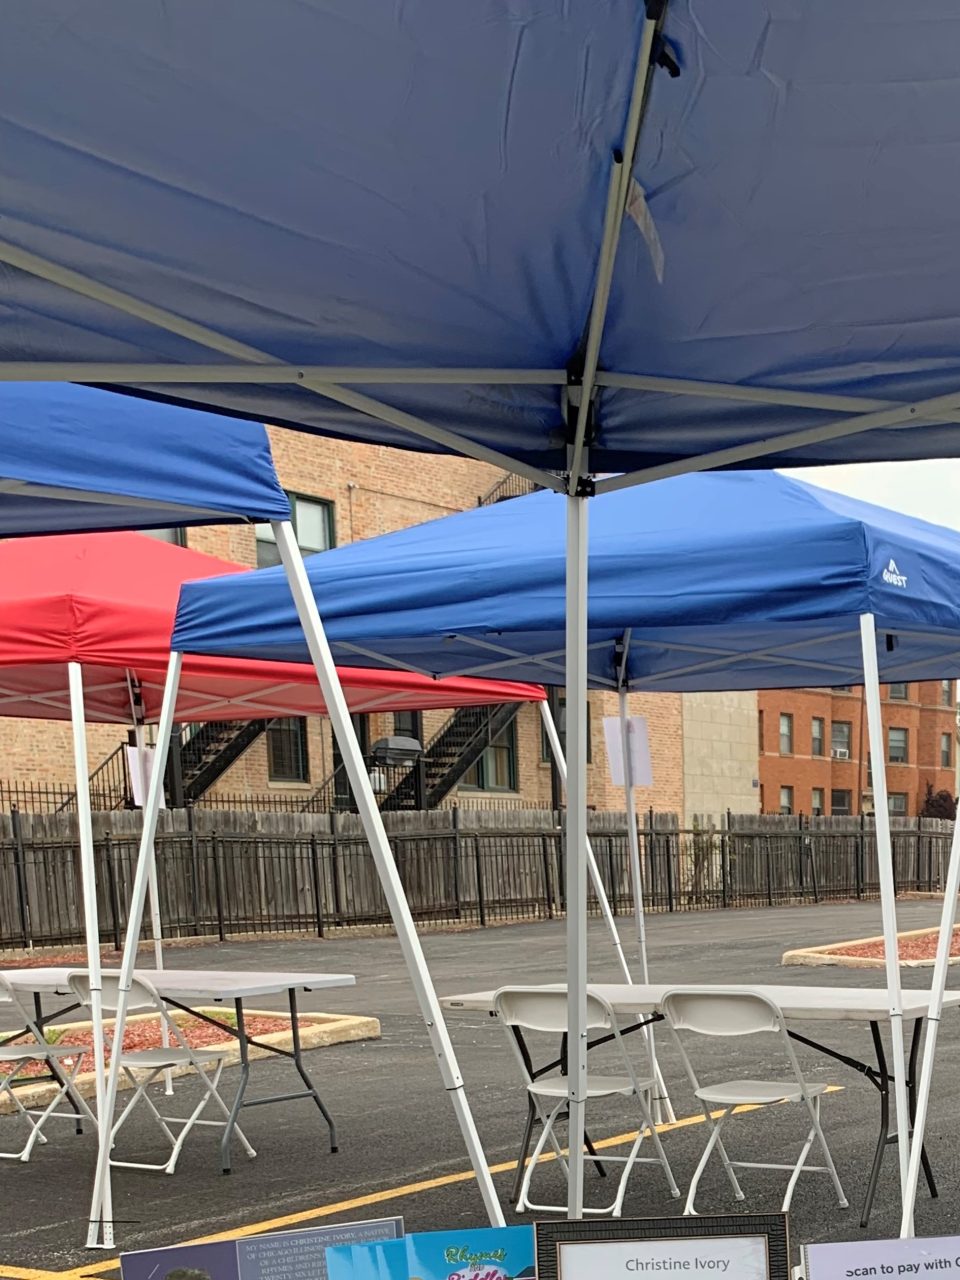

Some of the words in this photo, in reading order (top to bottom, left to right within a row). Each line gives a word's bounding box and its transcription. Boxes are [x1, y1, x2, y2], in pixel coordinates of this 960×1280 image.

[882, 568, 908, 588] QUEST
[445, 1245, 508, 1266] Rhymes
[625, 1257, 691, 1271] Christine
[694, 1257, 731, 1272] Ivory
[880, 1264, 895, 1274] to
[897, 1261, 922, 1275] pay
[923, 1258, 952, 1270] with
